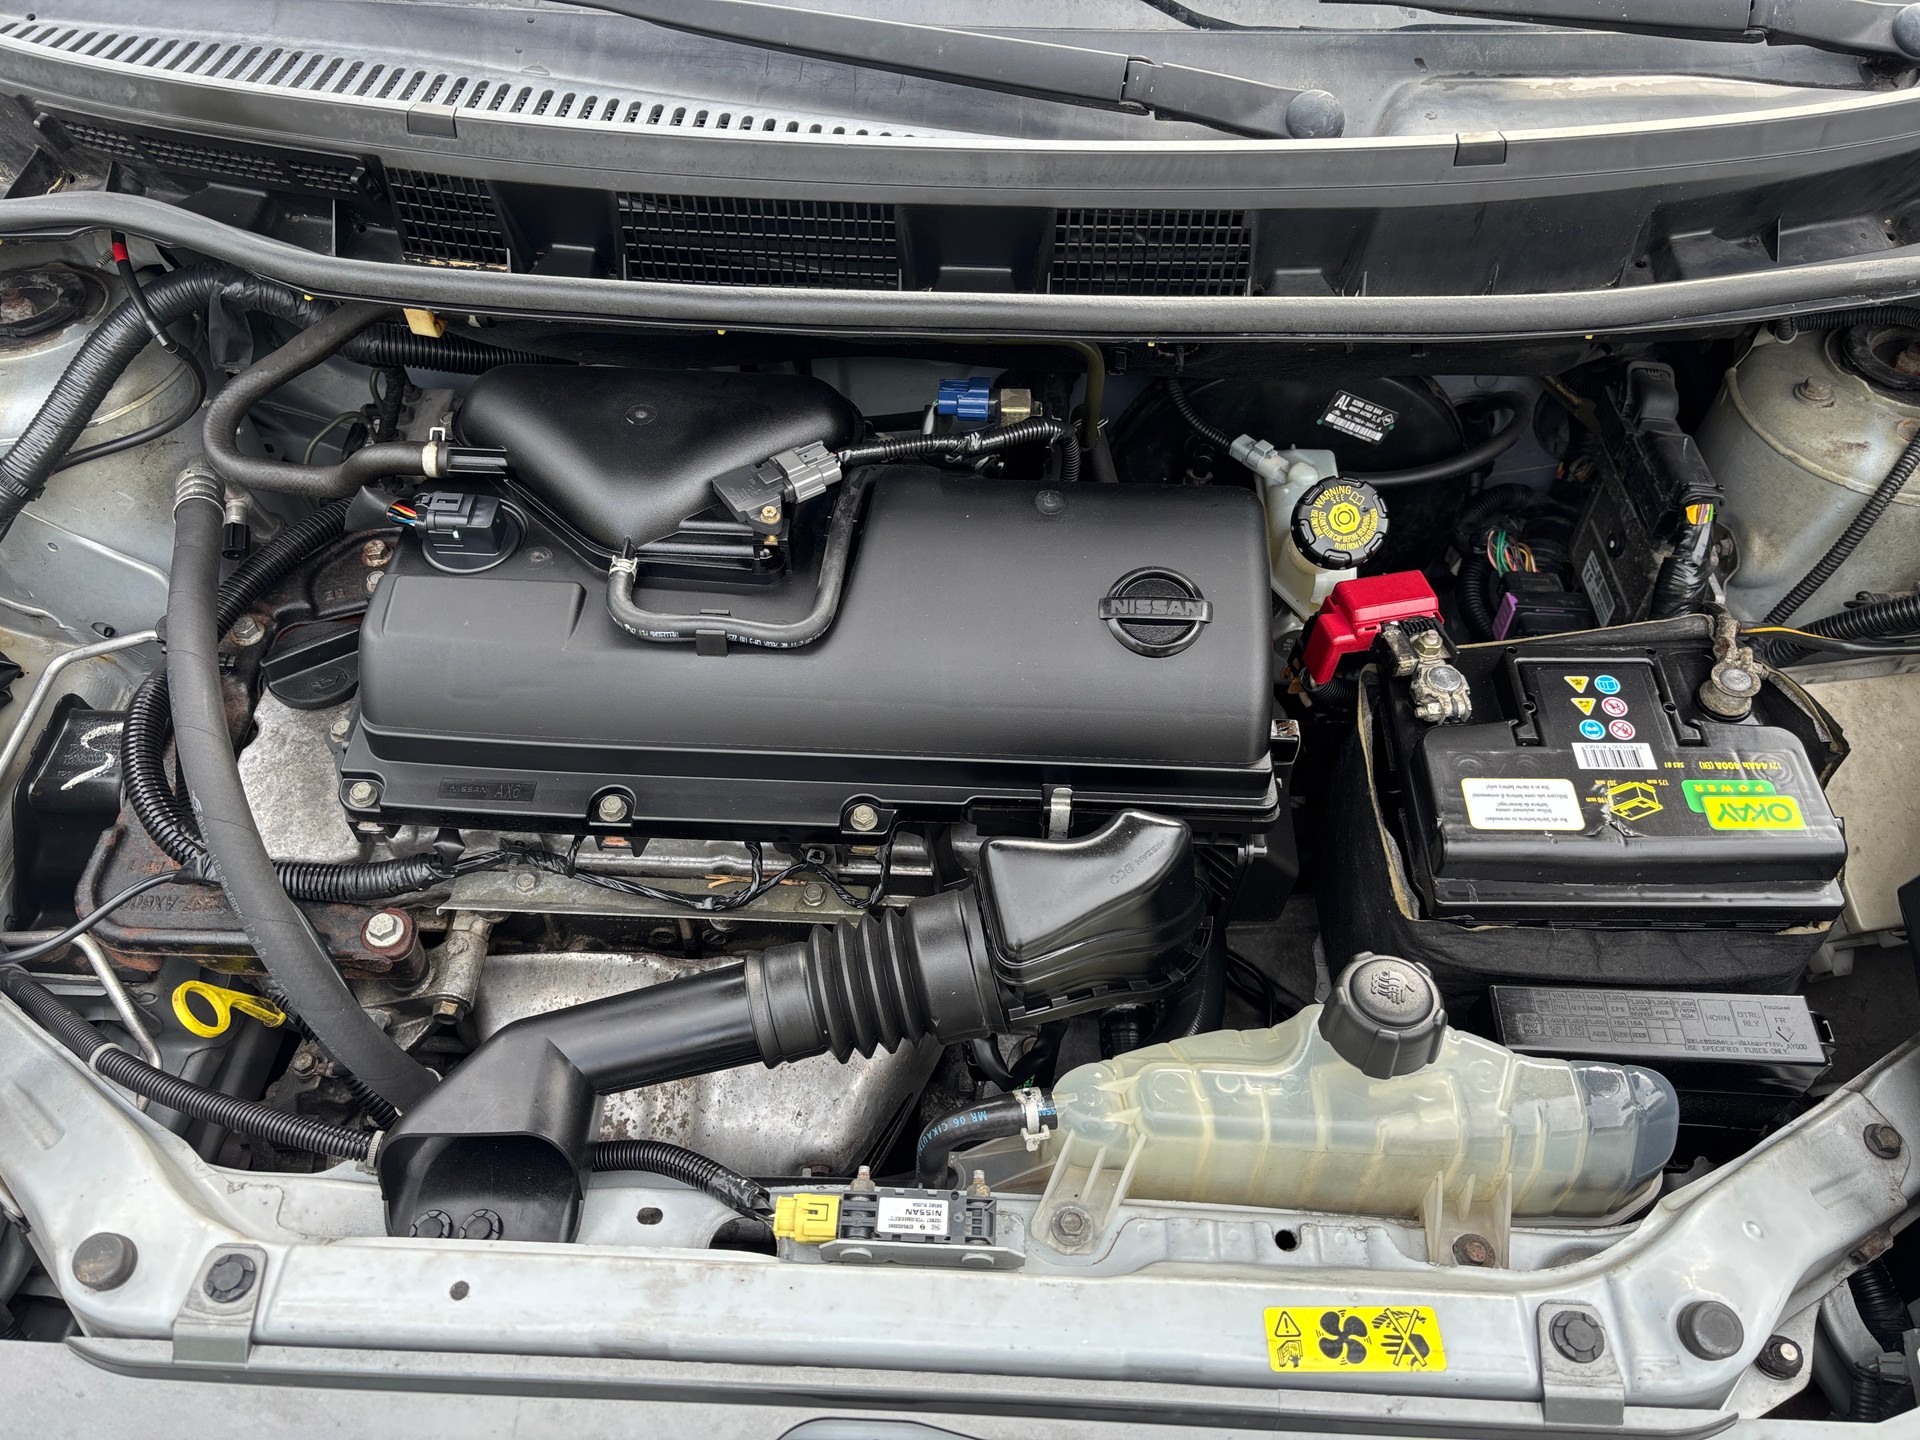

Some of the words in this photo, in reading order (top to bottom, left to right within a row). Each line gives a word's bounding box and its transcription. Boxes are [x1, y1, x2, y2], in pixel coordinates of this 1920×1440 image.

[1334, 394, 1351, 410] AL
[1314, 486, 1352, 508] WARNING
[1330, 495, 1345, 504] SEE
[1110, 598, 1204, 616] NISSAN
[1699, 760, 1713, 770] (EN)
[1714, 761, 1740, 770] 400A
[1742, 762, 1768, 770] 44Ah
[1769, 762, 1782, 770] 12V
[450, 786, 487, 794] NISSAN
[495, 784, 521, 799] AX6
[1694, 784, 1763, 792] POWER
[1717, 803, 1792, 823] OKAY
[1705, 1014, 1730, 1022] HORN
[1737, 1011, 1761, 1019] DTRL
[1702, 1045, 1738, 1053] SPECIFIED
[953, 1115, 966, 1127] 06
[971, 1110, 988, 1123] MR
